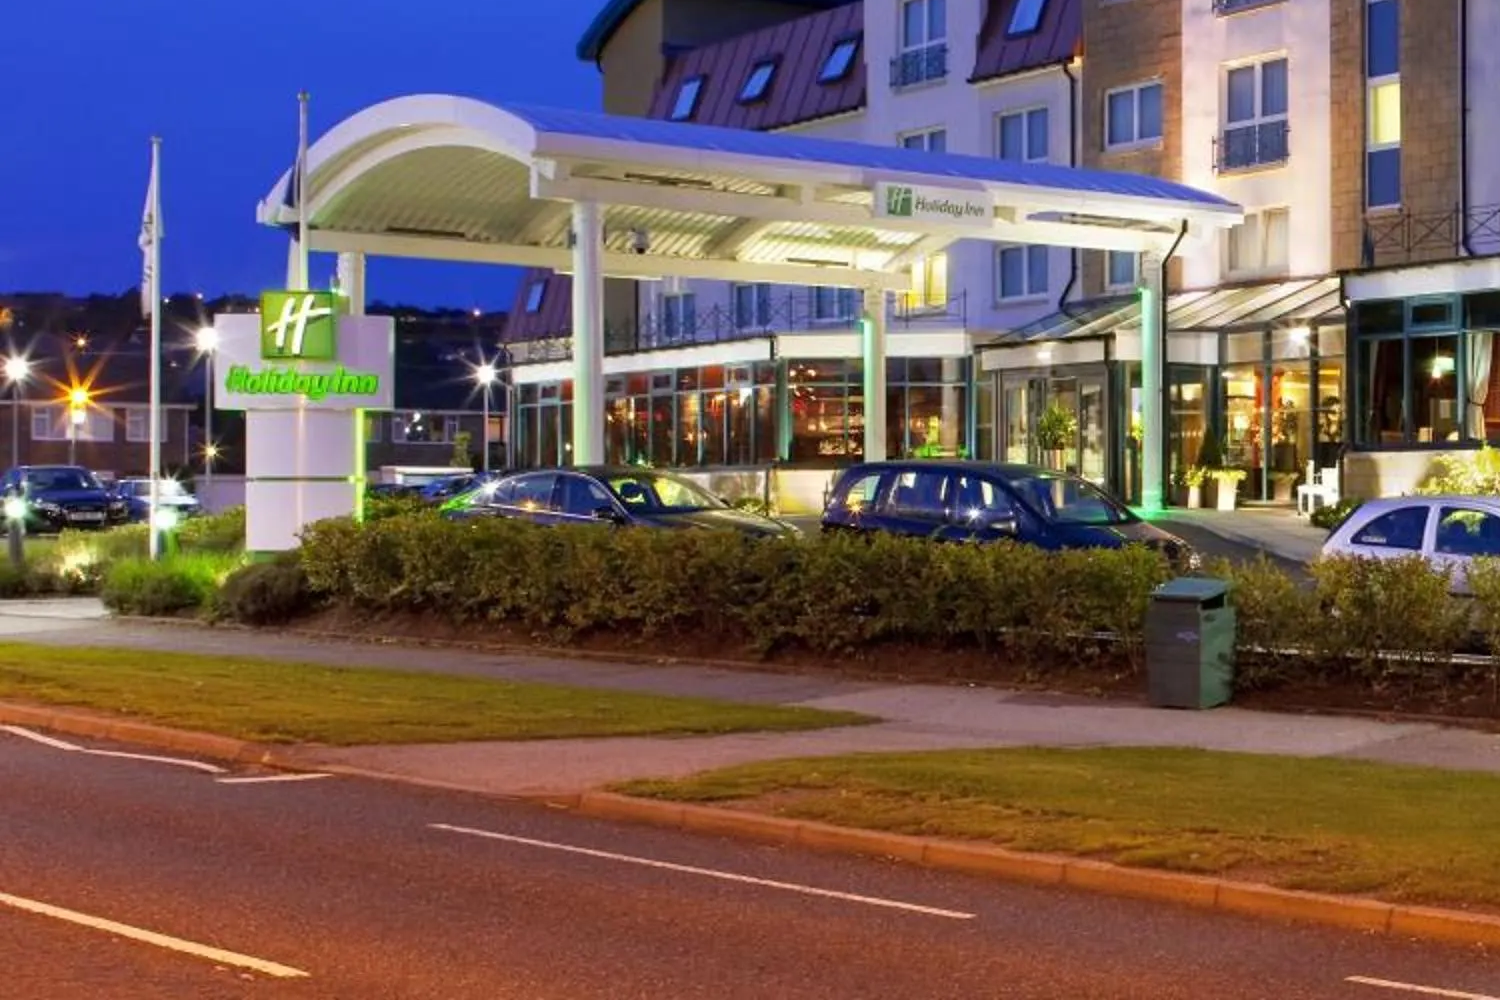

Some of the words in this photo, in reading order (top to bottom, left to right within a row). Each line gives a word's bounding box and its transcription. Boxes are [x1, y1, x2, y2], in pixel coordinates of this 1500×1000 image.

[914, 196, 963, 218] Holiday
[965, 202, 985, 217] Inn
[225, 365, 328, 401] Holiday
[332, 363, 379, 395] Inn
